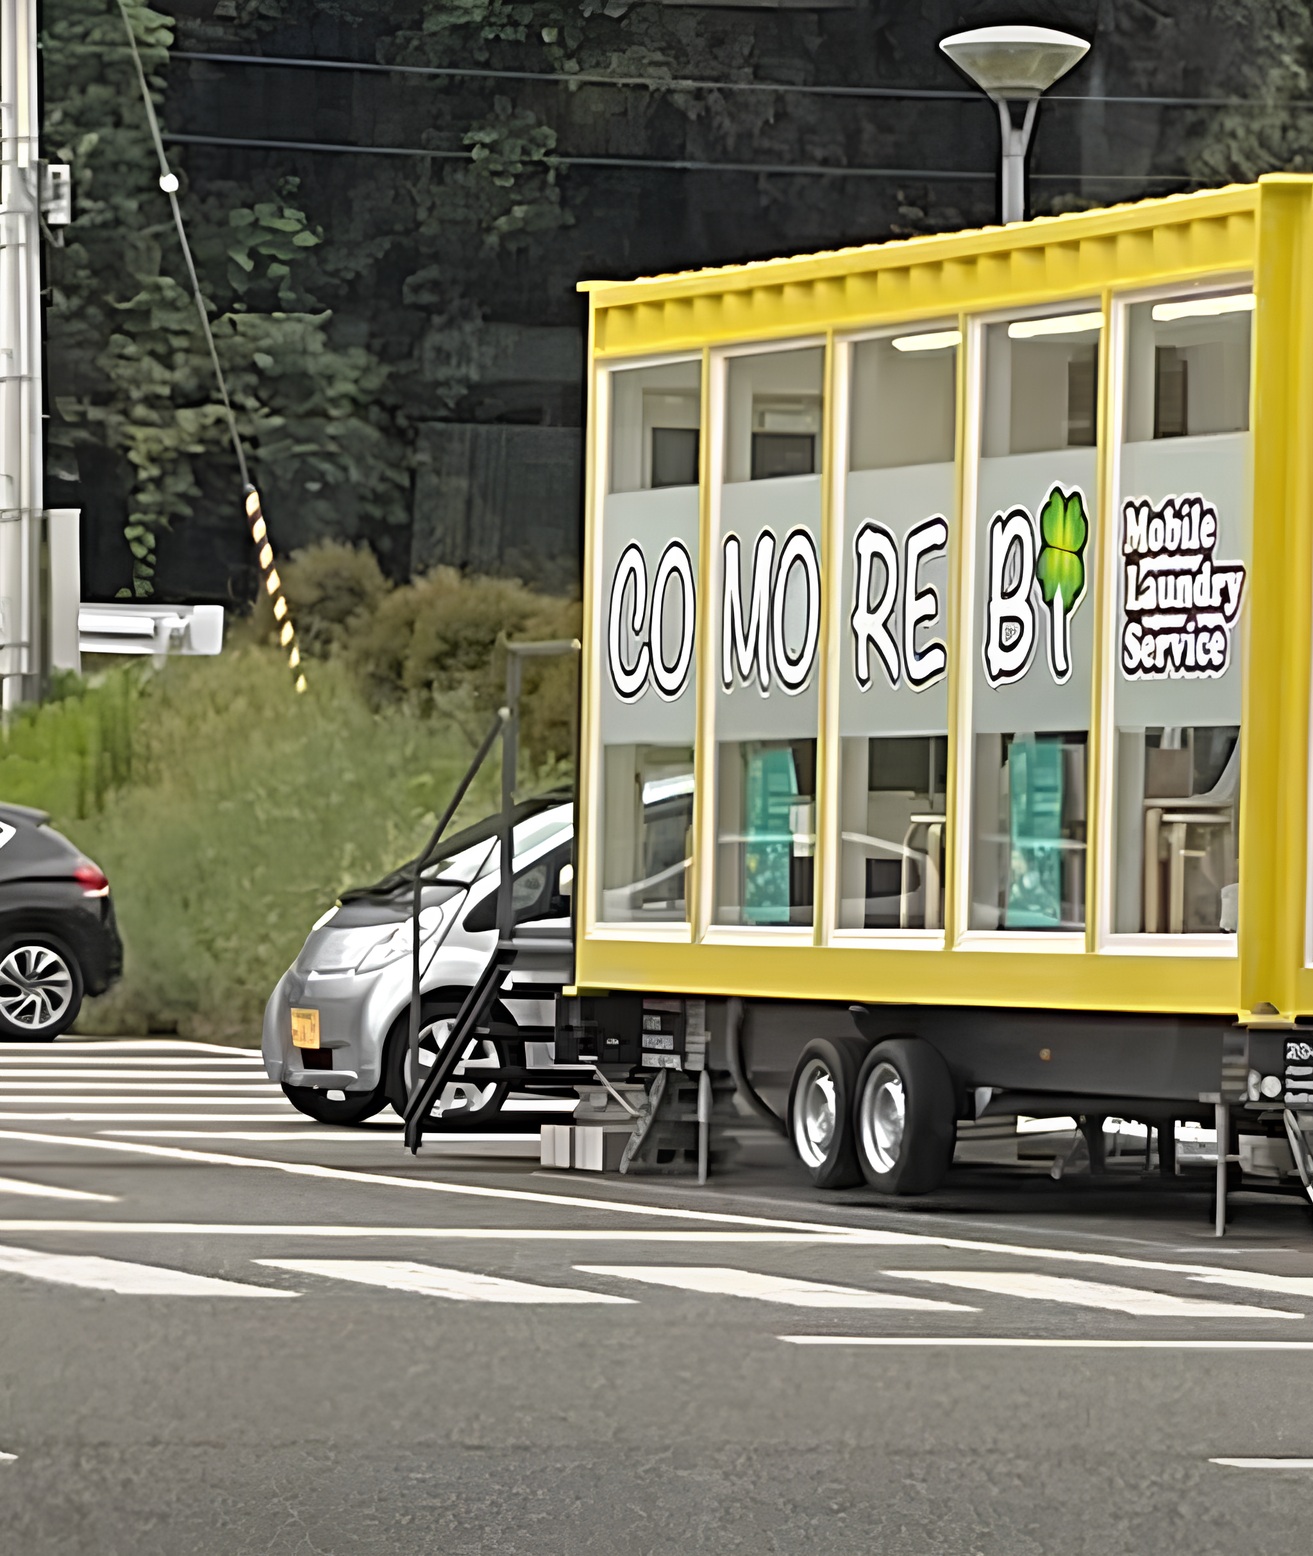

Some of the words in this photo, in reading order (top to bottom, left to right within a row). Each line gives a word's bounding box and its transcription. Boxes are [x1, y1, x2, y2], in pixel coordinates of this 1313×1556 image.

[1123, 501, 1218, 553] Mobile
[1125, 560, 1245, 616] Laundry
[1123, 621, 1226, 669] Service
